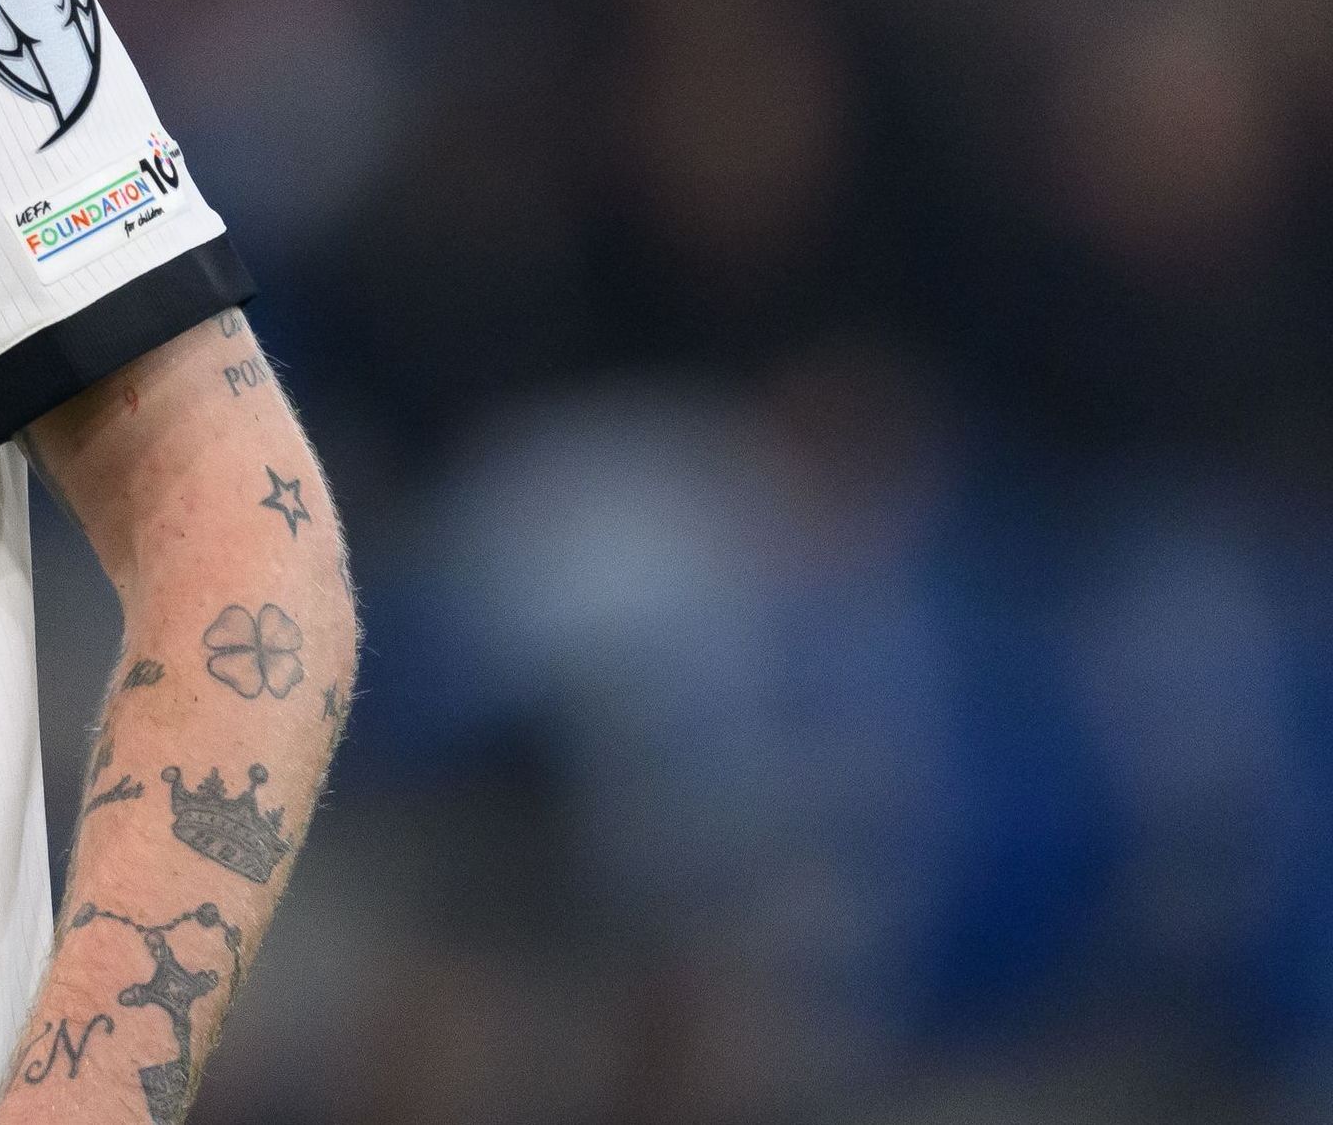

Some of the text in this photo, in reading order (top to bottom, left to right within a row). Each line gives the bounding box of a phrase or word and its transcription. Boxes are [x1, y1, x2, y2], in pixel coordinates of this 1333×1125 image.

[15, 200, 52, 227] UEFA
[26, 177, 151, 254] FOUNDATION
[124, 220, 135, 238] for
